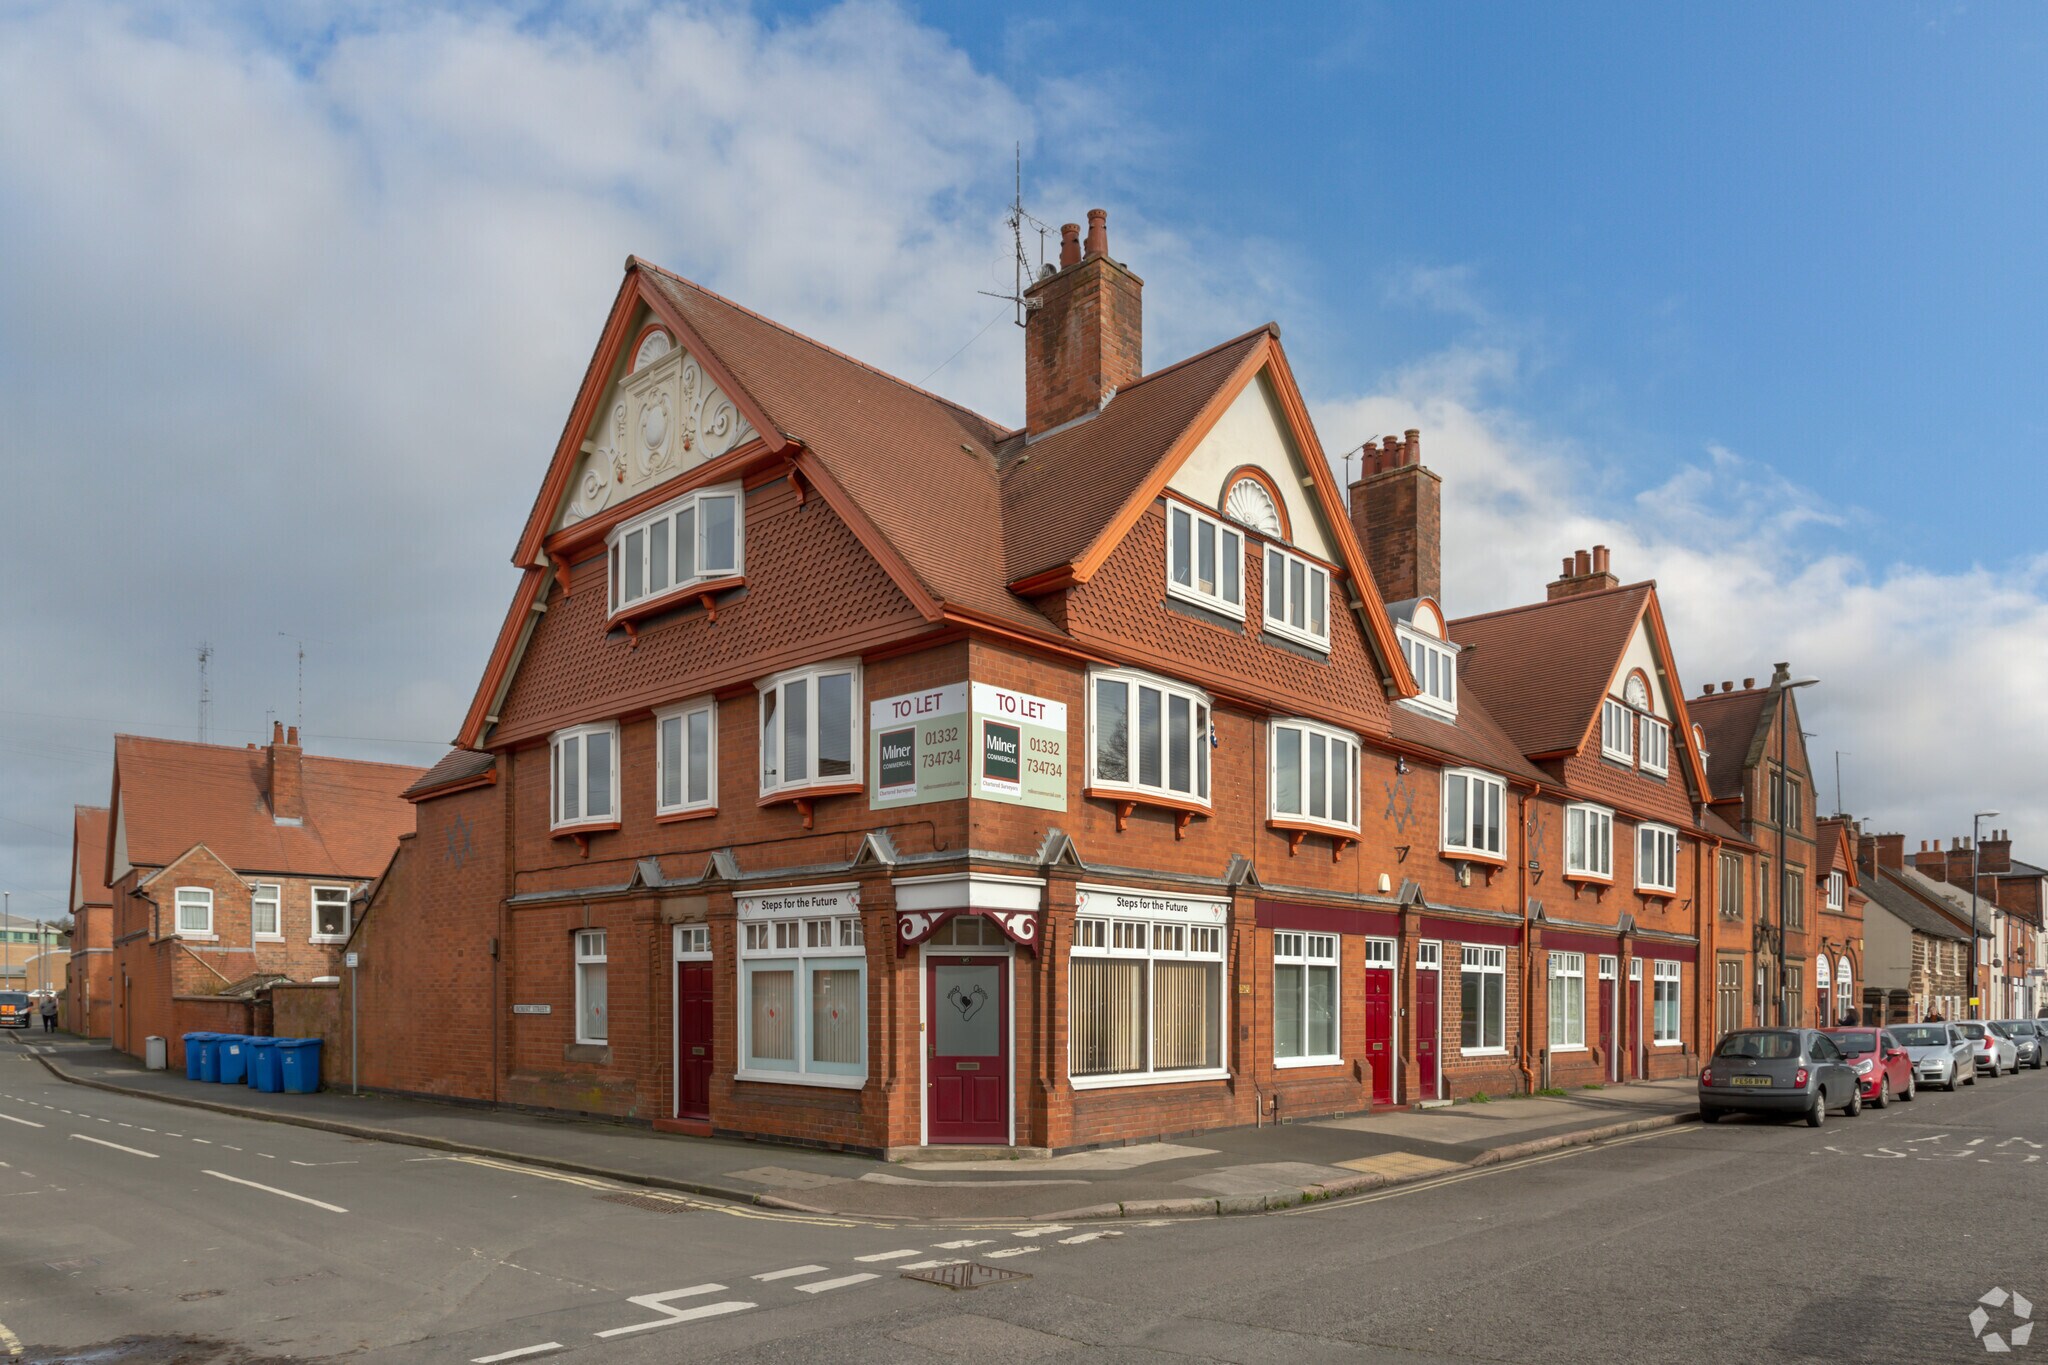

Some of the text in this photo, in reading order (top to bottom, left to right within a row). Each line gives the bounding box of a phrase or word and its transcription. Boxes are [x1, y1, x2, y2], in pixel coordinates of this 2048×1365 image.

[892, 693, 943, 719] TO LET
[996, 693, 1046, 720] TO LET
[925, 727, 958, 745] 01332
[986, 734, 1016, 754] Milner
[882, 744, 911, 760] Milner
[1029, 737, 1060, 756] 01332
[882, 760, 912, 770] COMMERCIAL
[922, 749, 961, 768] 734734
[986, 753, 1017, 765] COMMERCIAL
[1027, 758, 1062, 778] 734734
[761, 897, 838, 912] Steps for the Future
[1116, 897, 1188, 913] Steps for the Future
